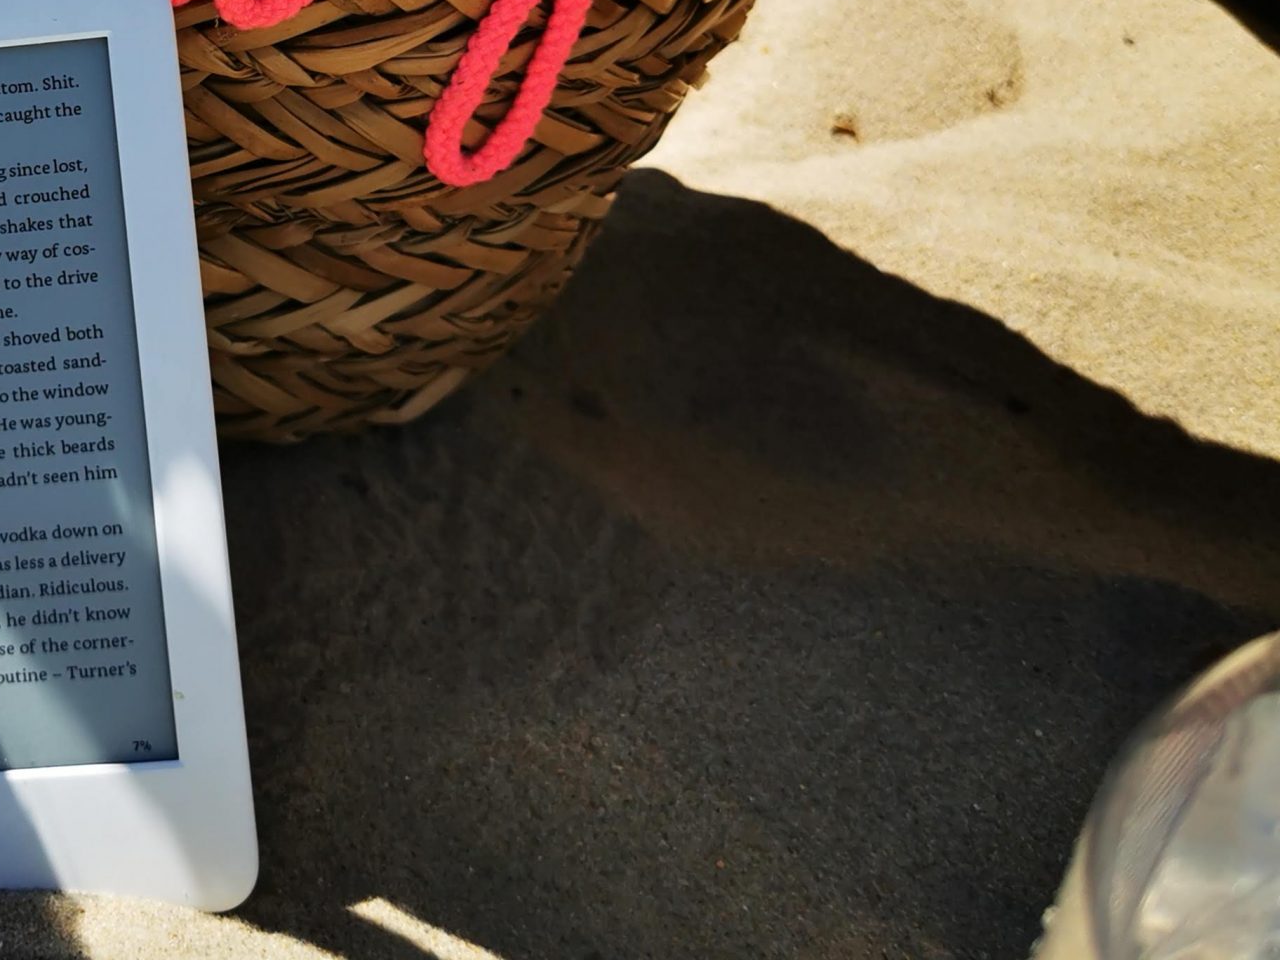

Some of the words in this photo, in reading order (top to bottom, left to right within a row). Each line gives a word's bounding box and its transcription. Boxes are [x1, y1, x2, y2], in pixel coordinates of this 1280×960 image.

[41, 73, 80, 92] Shit.
[53, 101, 82, 118] the
[13, 182, 91, 206] crouched
[57, 212, 94, 230] that
[2, 277, 22, 291] to
[24, 271, 53, 289] the
[56, 268, 99, 286] drive
[2, 326, 62, 347] shoved
[64, 323, 105, 342] both
[62, 351, 107, 371] sand-
[10, 385, 39, 403] the
[41, 380, 110, 400] window
[12, 439, 57, 459] thick
[59, 435, 116, 455] beards
[50, 523, 99, 540] down
[101, 523, 124, 536] on
[38, 577, 129, 598] Ridiculous.
[18, 637, 37, 655] of
[40, 636, 69, 655] the
[72, 635, 135, 651] corner-
[132, 740, 152, 752] 7%
